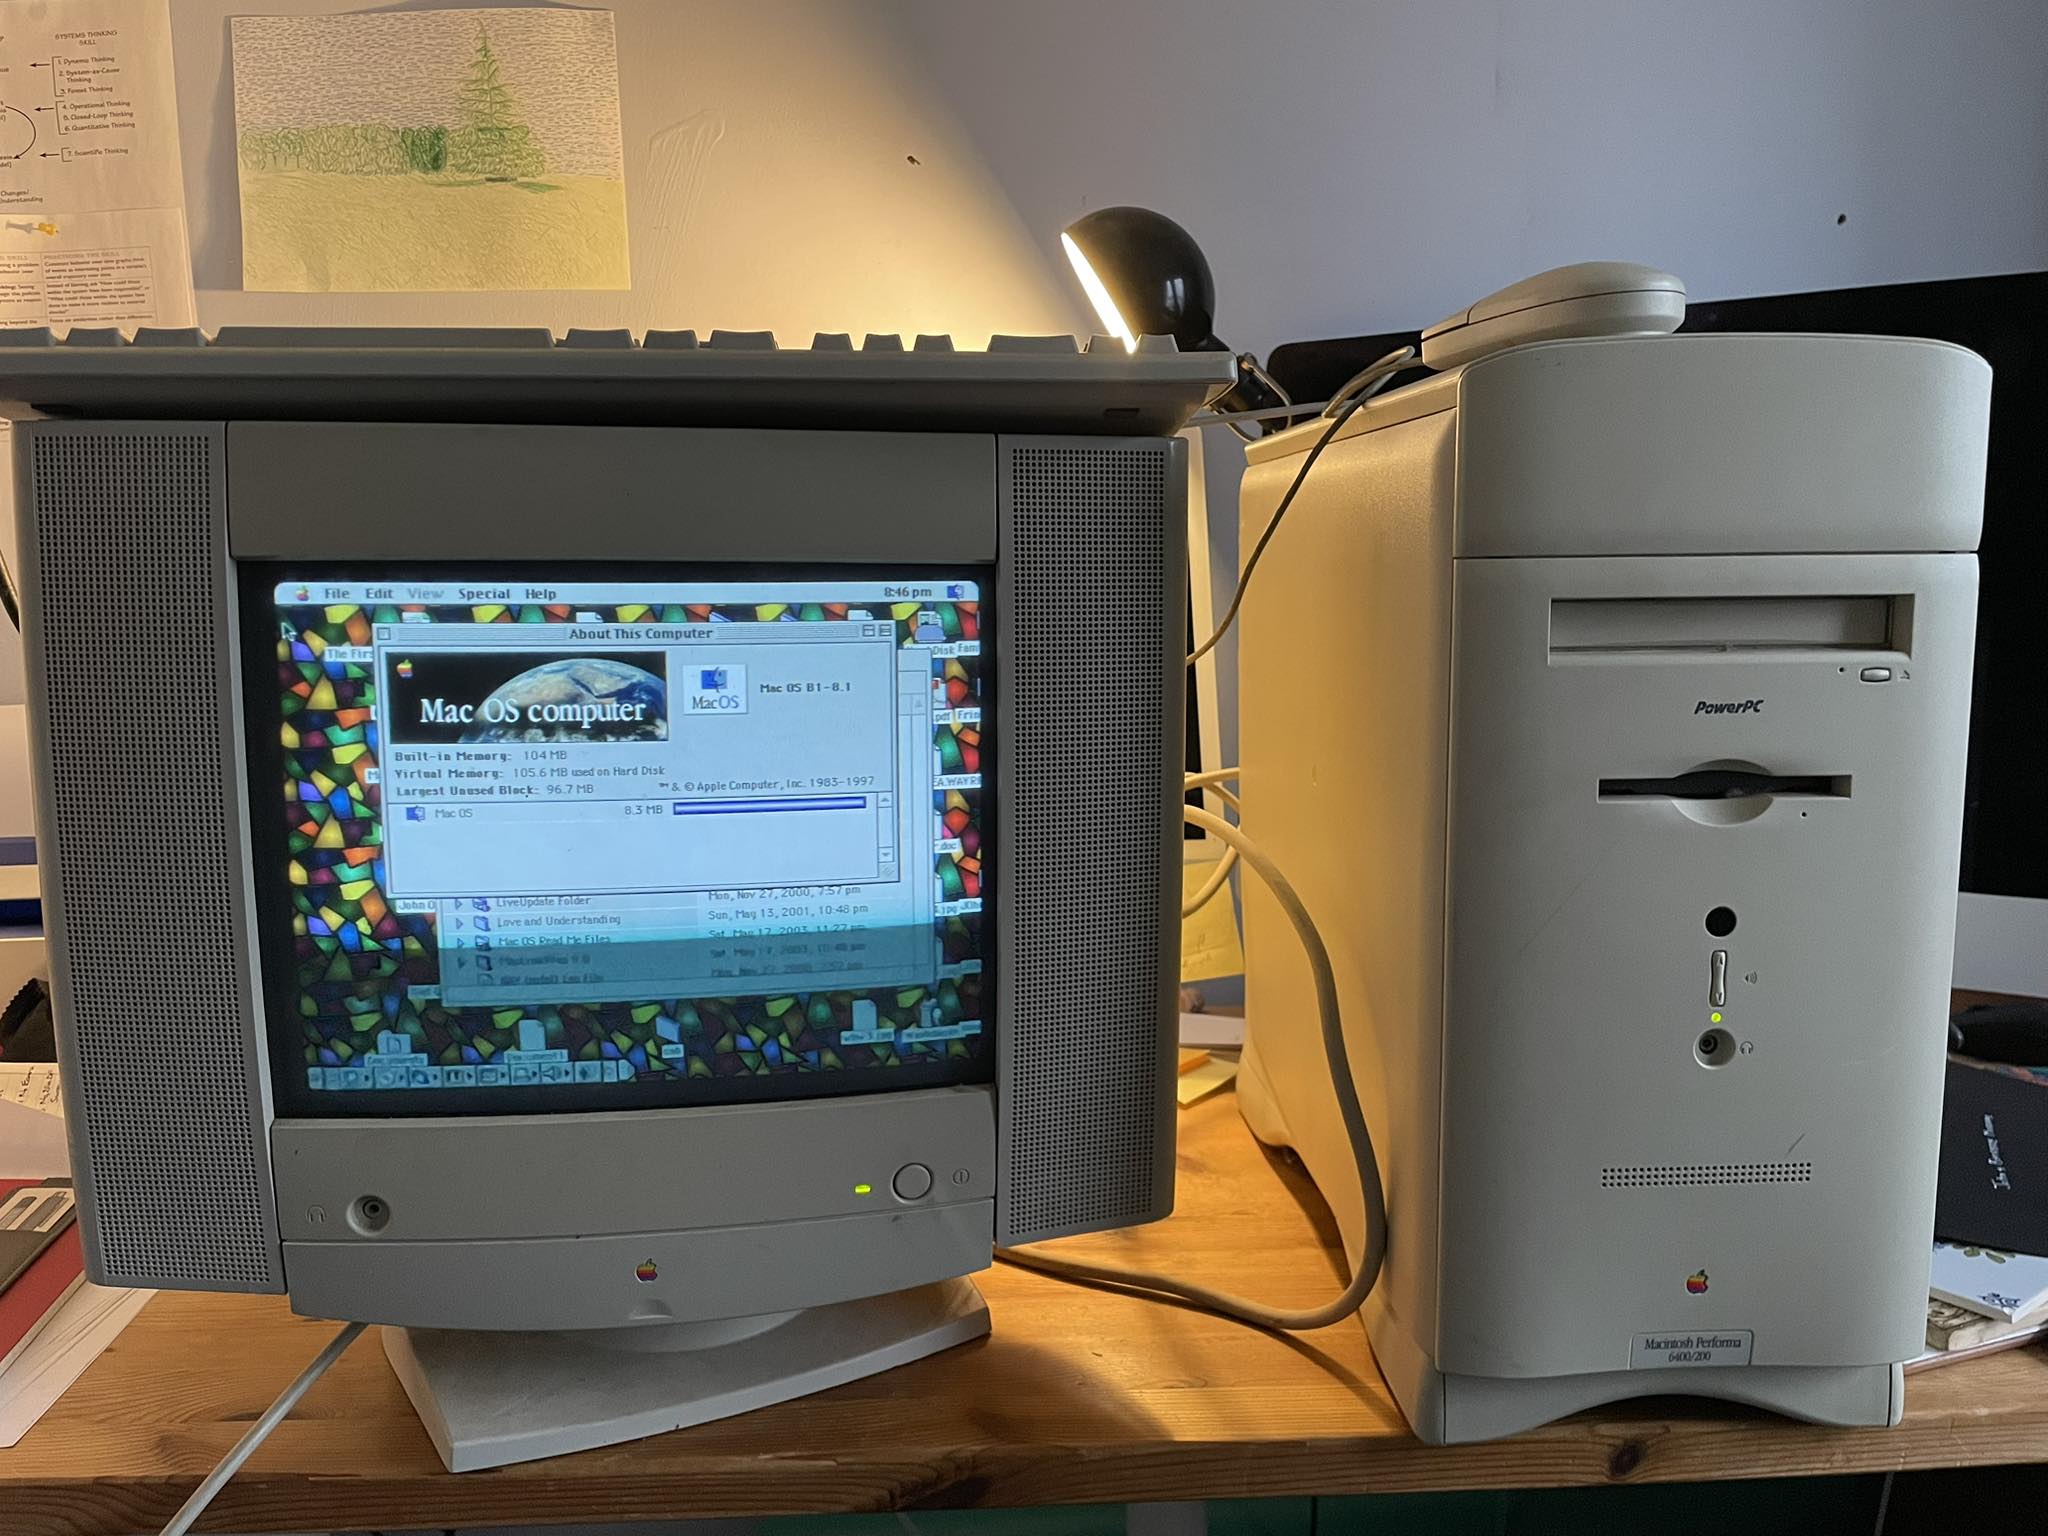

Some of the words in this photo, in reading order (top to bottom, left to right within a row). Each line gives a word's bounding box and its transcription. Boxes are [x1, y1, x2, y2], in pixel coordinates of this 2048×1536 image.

[325, 587, 350, 599] File
[365, 587, 394, 599] Edit
[407, 588, 445, 599] View
[459, 588, 511, 601] Special
[525, 588, 557, 601] Help
[884, 586, 910, 597] 8:46
[912, 588, 933, 599] pm
[569, 628, 611, 640] About
[614, 628, 641, 640] This
[645, 627, 714, 640] Computer
[759, 683, 783, 693] Mac
[786, 683, 802, 693] OS
[806, 682, 851, 692] B1-8.1
[692, 695, 740, 710] MacOS
[1694, 699, 1765, 715] PowerPC
[420, 698, 474, 723] Mac
[483, 697, 521, 723] OS
[527, 698, 648, 729] computer
[395, 752, 451, 761] Built-in
[456, 751, 512, 763] Memory:
[524, 751, 547, 760] 104
[550, 750, 567, 760] MB
[394, 769, 442, 779] Virtual
[448, 768, 504, 780] Memory:
[514, 767, 547, 778] 105.6
[550, 767, 568, 777] MB
[571, 767, 594, 777] used
[613, 766, 638, 776] Hard
[641, 766, 665, 775] Disk
[396, 786, 446, 798] Largest
[450, 786, 494, 796] Unused
[499, 785, 539, 795] Block:
[546, 784, 573, 794] 96.7
[576, 784, 594, 794] MB
[697, 781, 727, 793] Apple
[810, 776, 875, 787] 1983-1997
[435, 808, 456, 818] Mac
[459, 808, 473, 817] OS
[624, 805, 643, 815] 8.3
[646, 804, 663, 814] MB
[496, 897, 554, 908] LiveUpdate
[708, 890, 734, 901] Mon,
[737, 889, 755, 900] Nov
[759, 888, 778, 900] 27,
[781, 886, 814, 898] 2000,
[818, 886, 842, 896] 7:57
[845, 887, 861, 896] pm
[497, 917, 521, 927] Love
[524, 916, 543, 926] and
[545, 914, 621, 926] Understanding
[708, 910, 732, 921] Sun,
[735, 910, 757, 921] May
[761, 907, 778, 918] 13,
[782, 906, 814, 917] 2001,
[818, 904, 849, 915] 10:48
[853, 905, 869, 915] pm
[498, 937, 519, 946] Mac
[521, 936, 536, 946] OS
[566, 935, 581, 945] Me
[585, 934, 611, 944] Files
[1644, 1336, 1693, 1350] Macintosh
[1696, 1335, 1742, 1349] Performa
[1668, 1350, 1712, 1362] 6400/200
